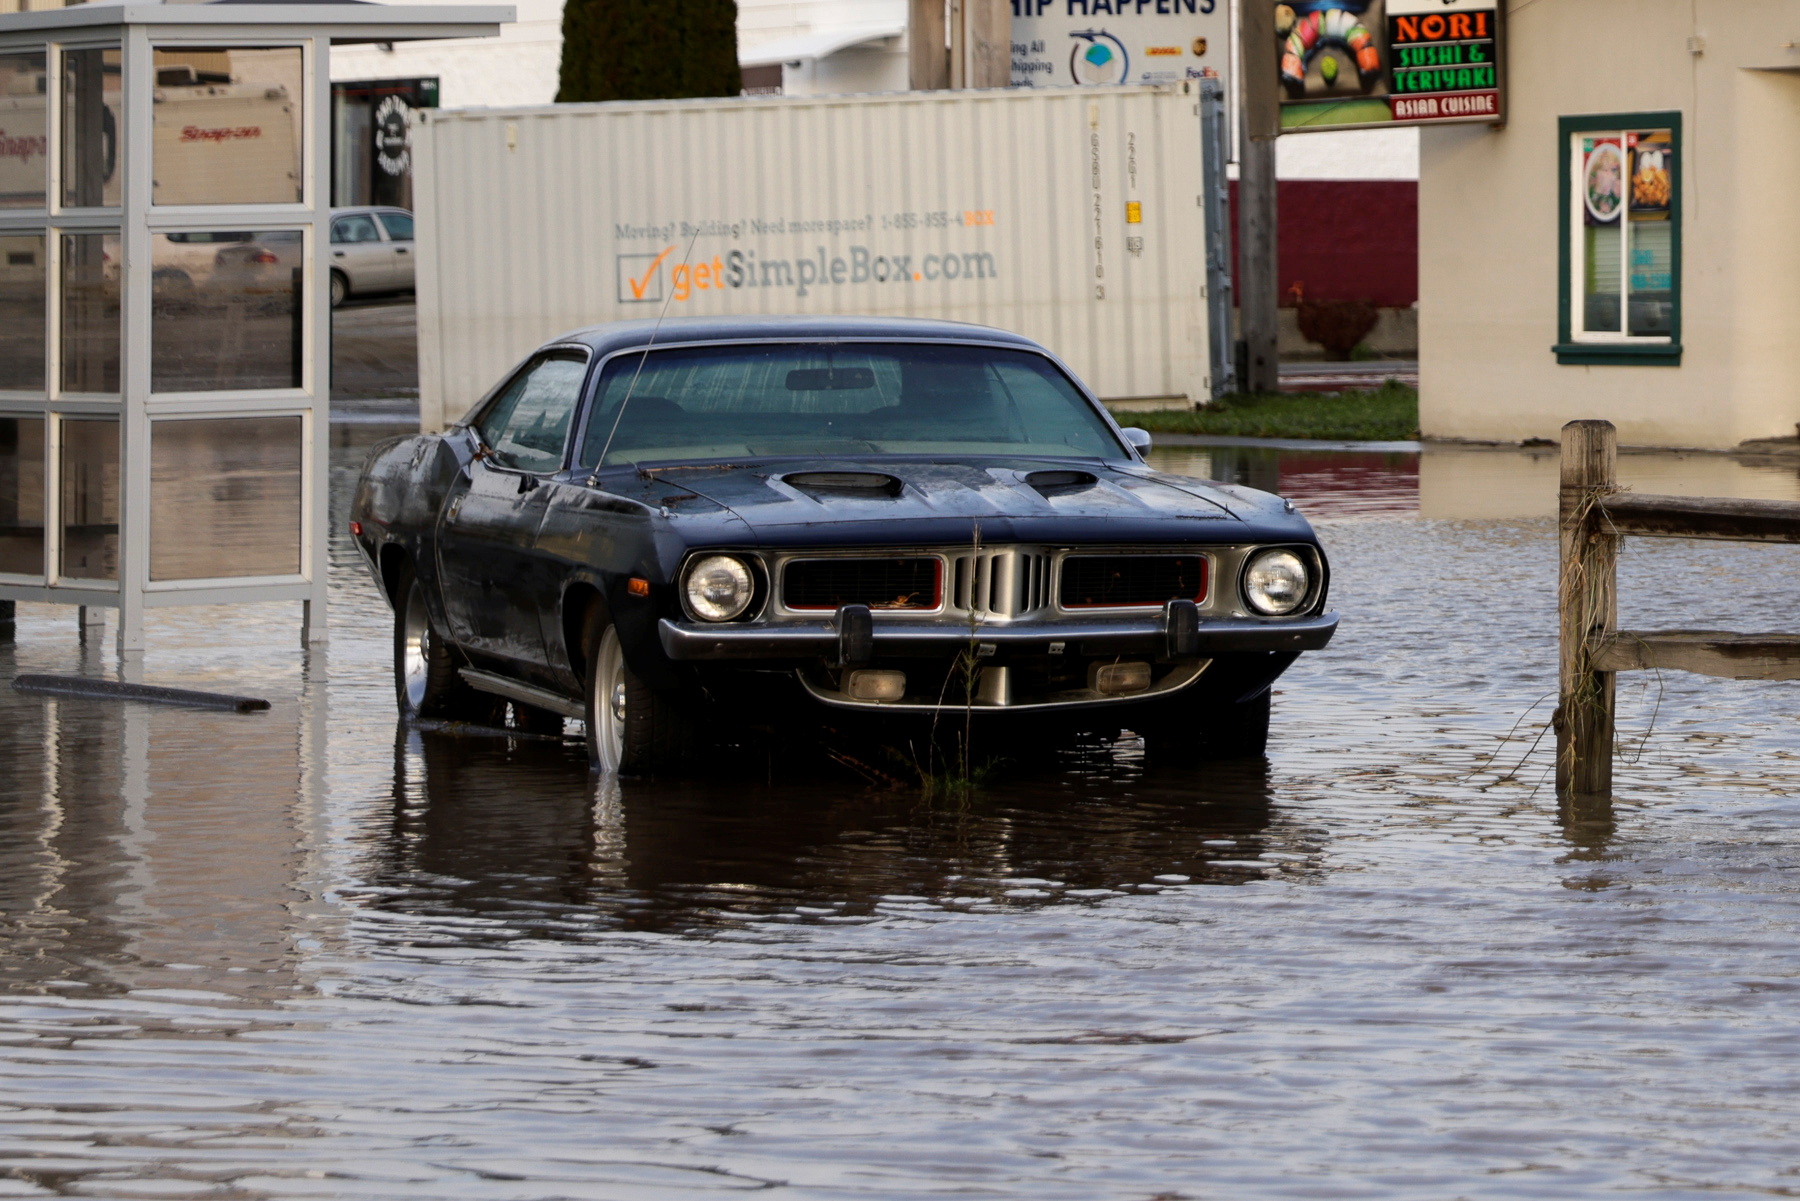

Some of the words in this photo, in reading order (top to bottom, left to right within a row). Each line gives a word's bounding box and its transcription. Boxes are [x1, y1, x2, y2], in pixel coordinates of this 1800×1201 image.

[1396, 12, 1488, 42] NORI
[1010, 39, 1027, 56] ing
[1400, 45, 1462, 68] SUSHI
[1468, 43, 1486, 63] &
[1011, 58, 1053, 74] hipping
[1393, 67, 1495, 92] TERIYAKI
[1395, 99, 1438, 118] ASIAN
[1440, 95, 1495, 115] CUISINE
[615, 222, 676, 242] Moving?
[751, 216, 785, 235] Need
[671, 245, 997, 302] getSimpleBox.com
